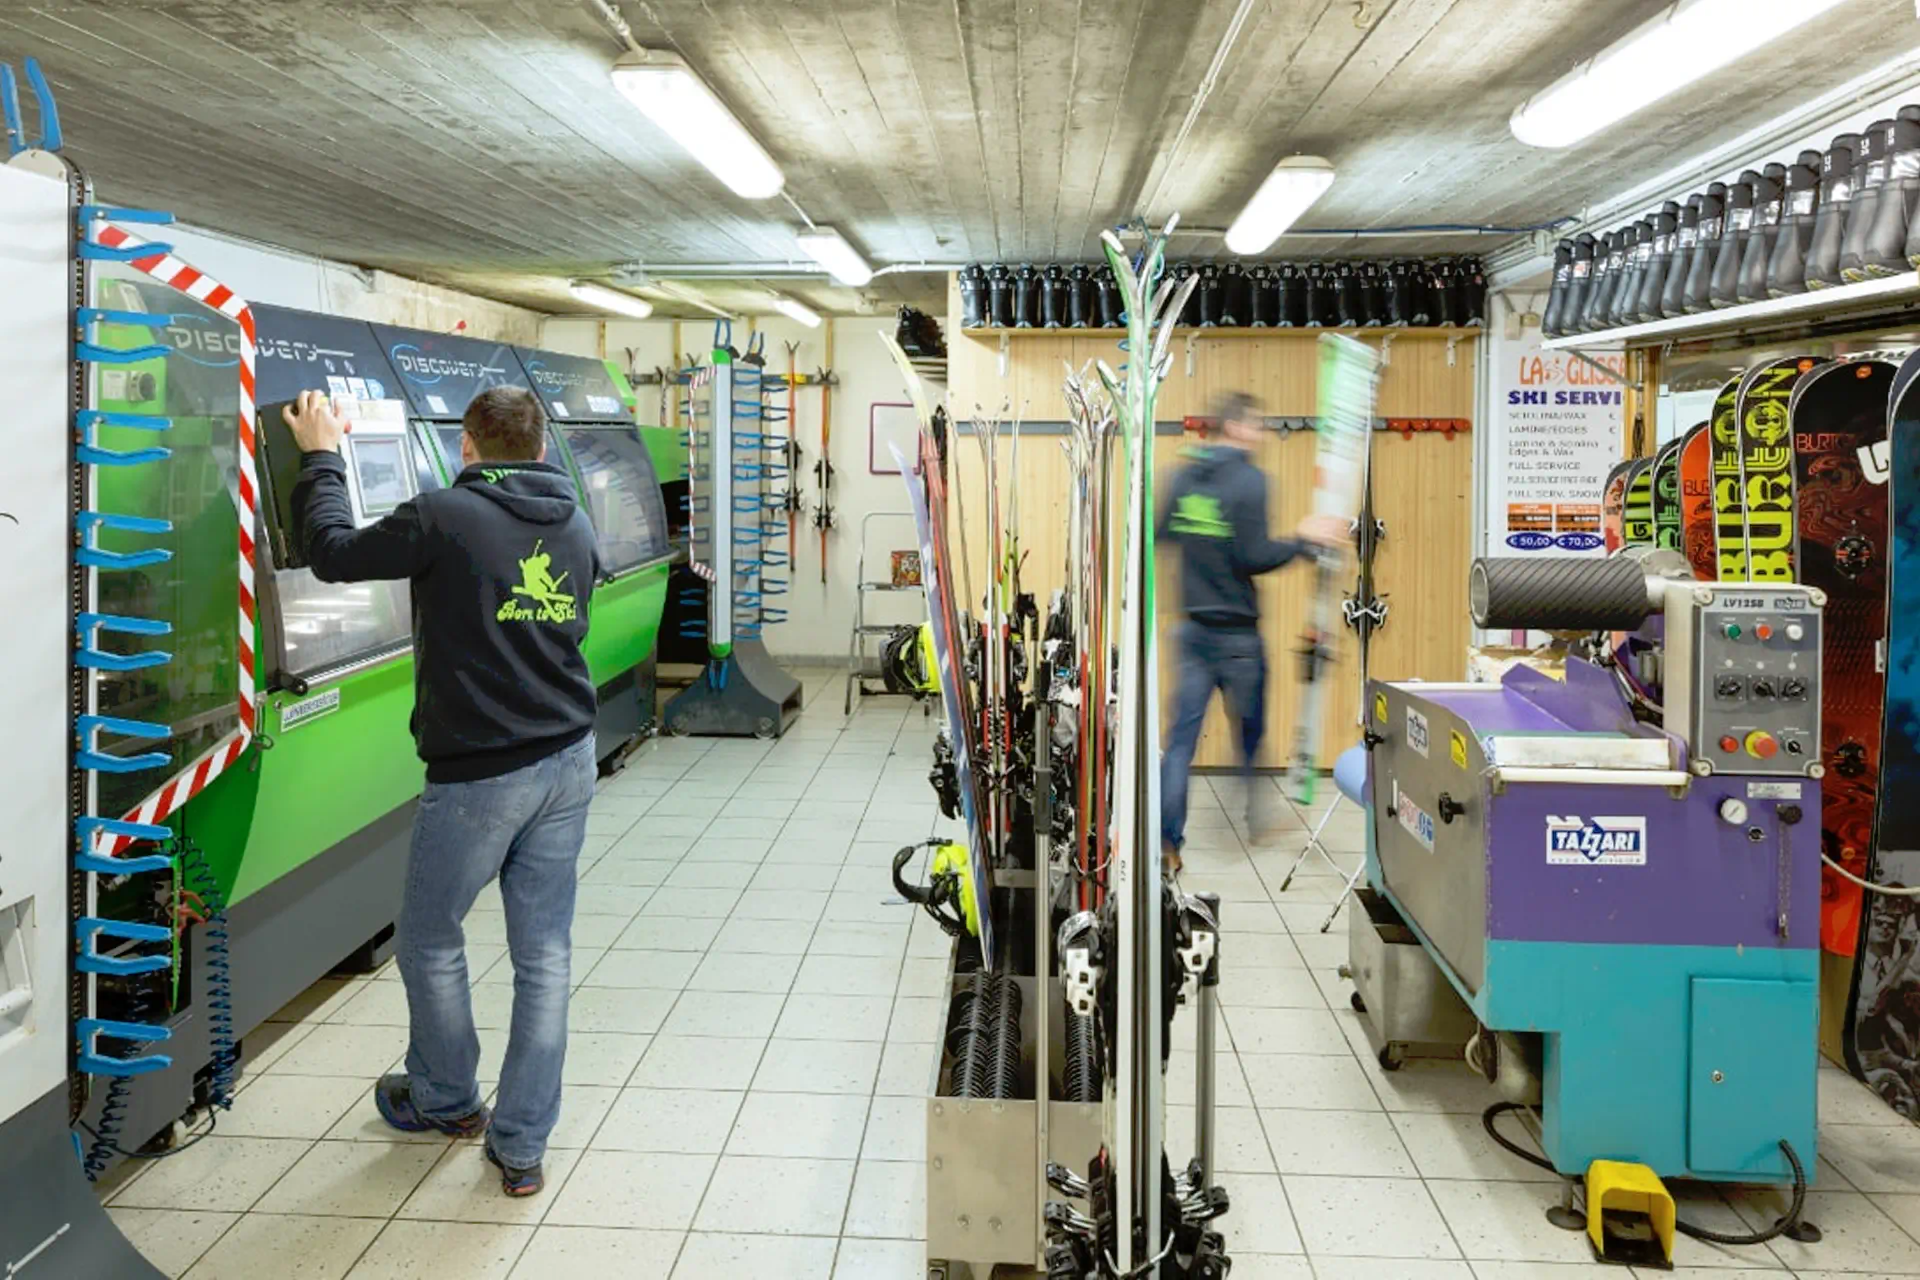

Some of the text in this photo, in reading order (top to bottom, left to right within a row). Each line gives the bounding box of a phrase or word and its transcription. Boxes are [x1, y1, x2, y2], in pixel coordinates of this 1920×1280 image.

[167, 326, 353, 361] DISCVERY
[1519, 356, 1543, 385] LA
[1508, 390, 1621, 405] SKI SERVI
[1508, 462, 1532, 470] FULL
[1536, 462, 1581, 470] SERVICE
[1568, 490, 1602, 498] SNOW
[497, 598, 534, 623] Born
[1556, 826, 1635, 857] TAZZARI
